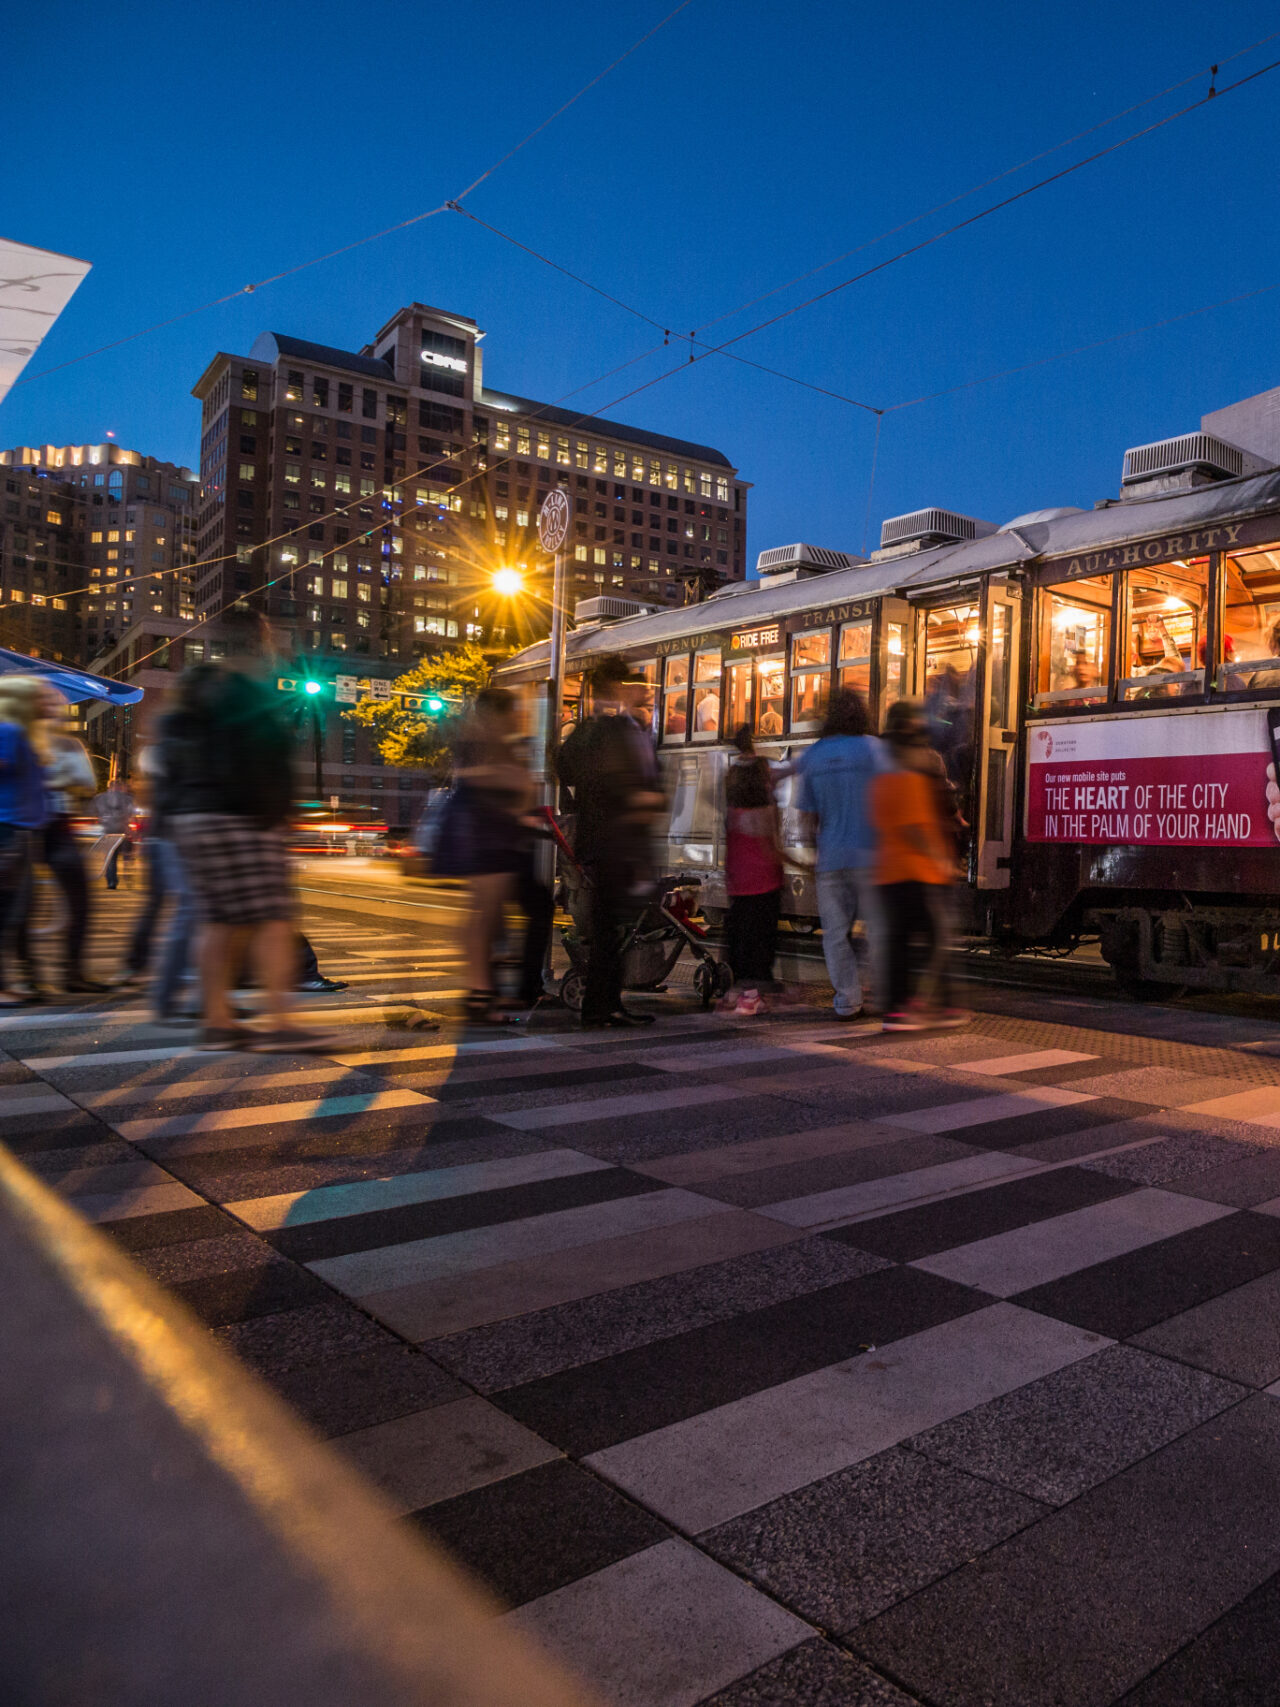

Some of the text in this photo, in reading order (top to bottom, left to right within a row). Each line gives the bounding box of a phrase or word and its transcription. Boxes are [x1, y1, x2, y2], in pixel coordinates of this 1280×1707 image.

[1066, 524, 1245, 577] AUTHORITY
[740, 629, 779, 649] RIDE FREE
[1045, 770, 1126, 783] Our new mobile site puts
[1045, 783, 1229, 810] THE HEART OF THE CITY
[1045, 813, 1251, 839] IN THE PALM OF YOUR HAND
